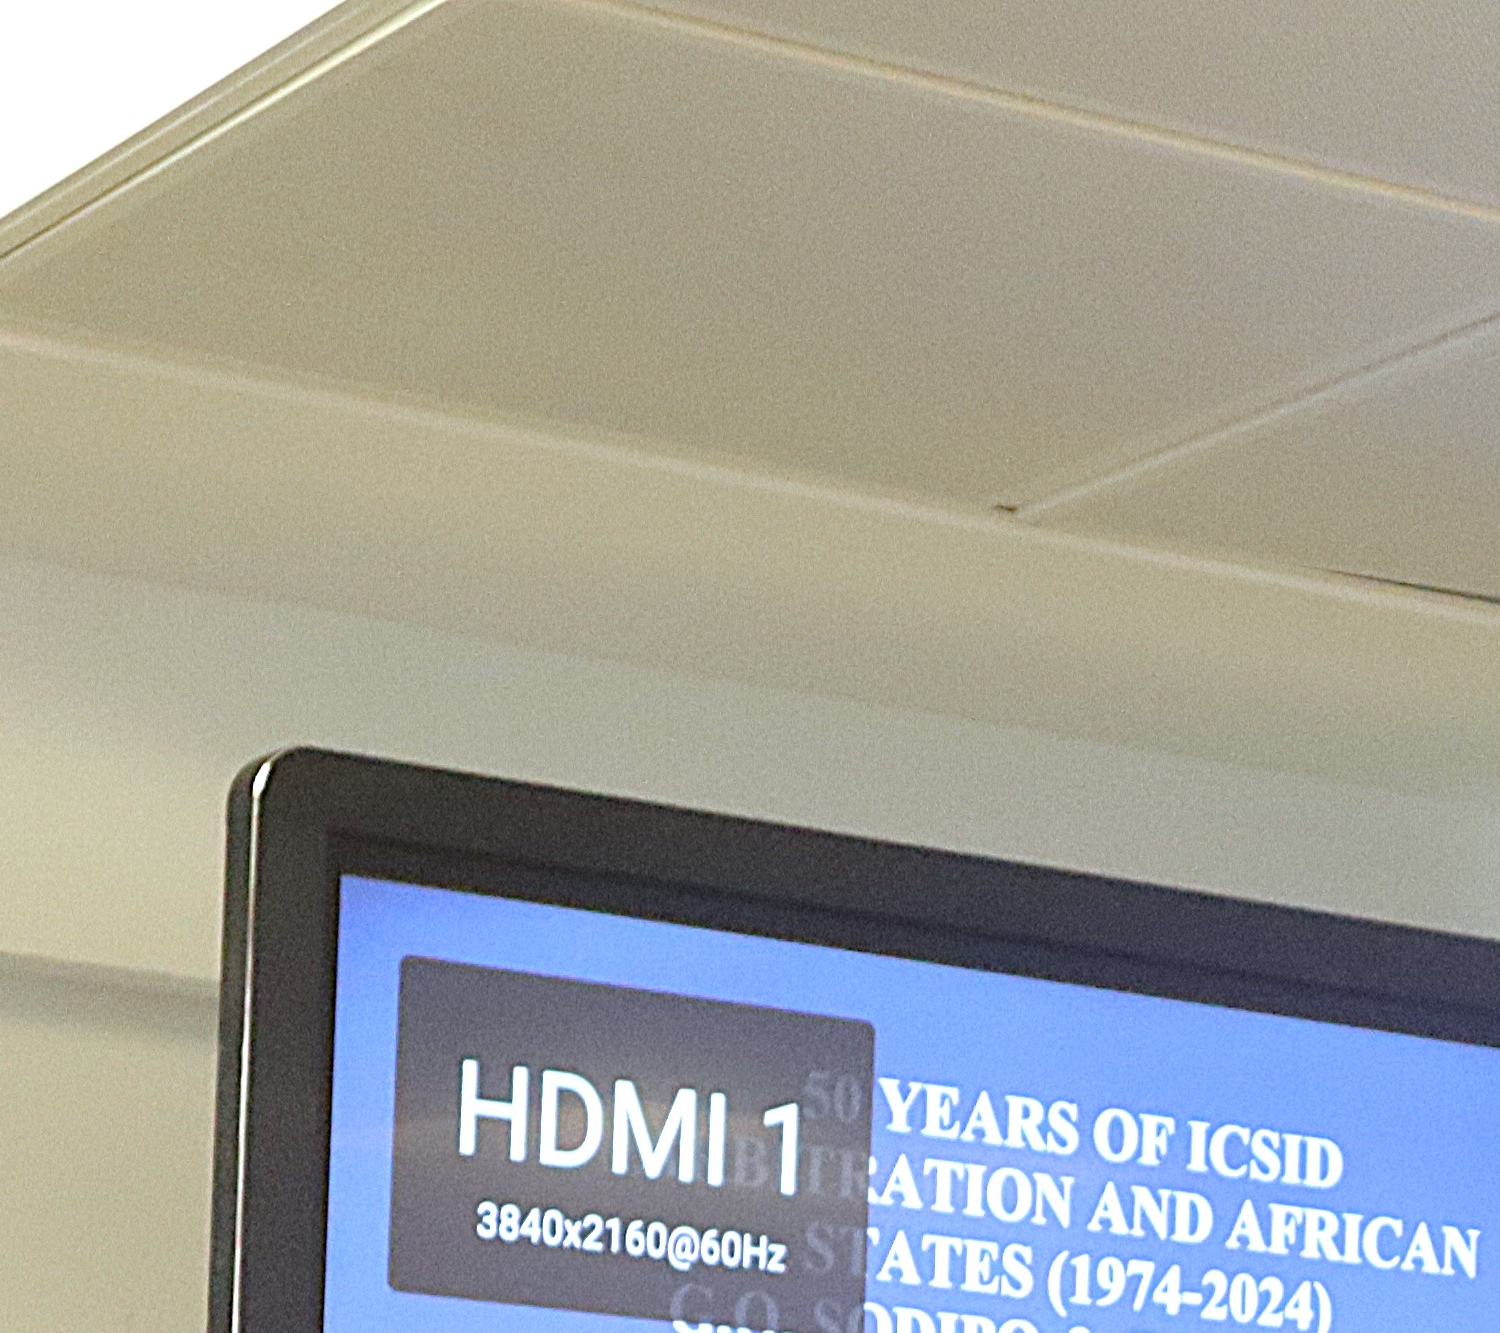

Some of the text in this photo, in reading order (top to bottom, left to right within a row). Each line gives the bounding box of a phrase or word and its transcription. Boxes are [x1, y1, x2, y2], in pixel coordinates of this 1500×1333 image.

[459, 1058, 799, 1196] HDMI 1
[878, 1077, 1079, 1155] YEARS
[1093, 1106, 1175, 1167] OF
[1187, 1120, 1344, 1190] ICSID
[476, 1200, 787, 1273] 3840x2160@60Hz
[1087, 1181, 1213, 1244] AND
[1226, 1198, 1481, 1279] AFRICAN
